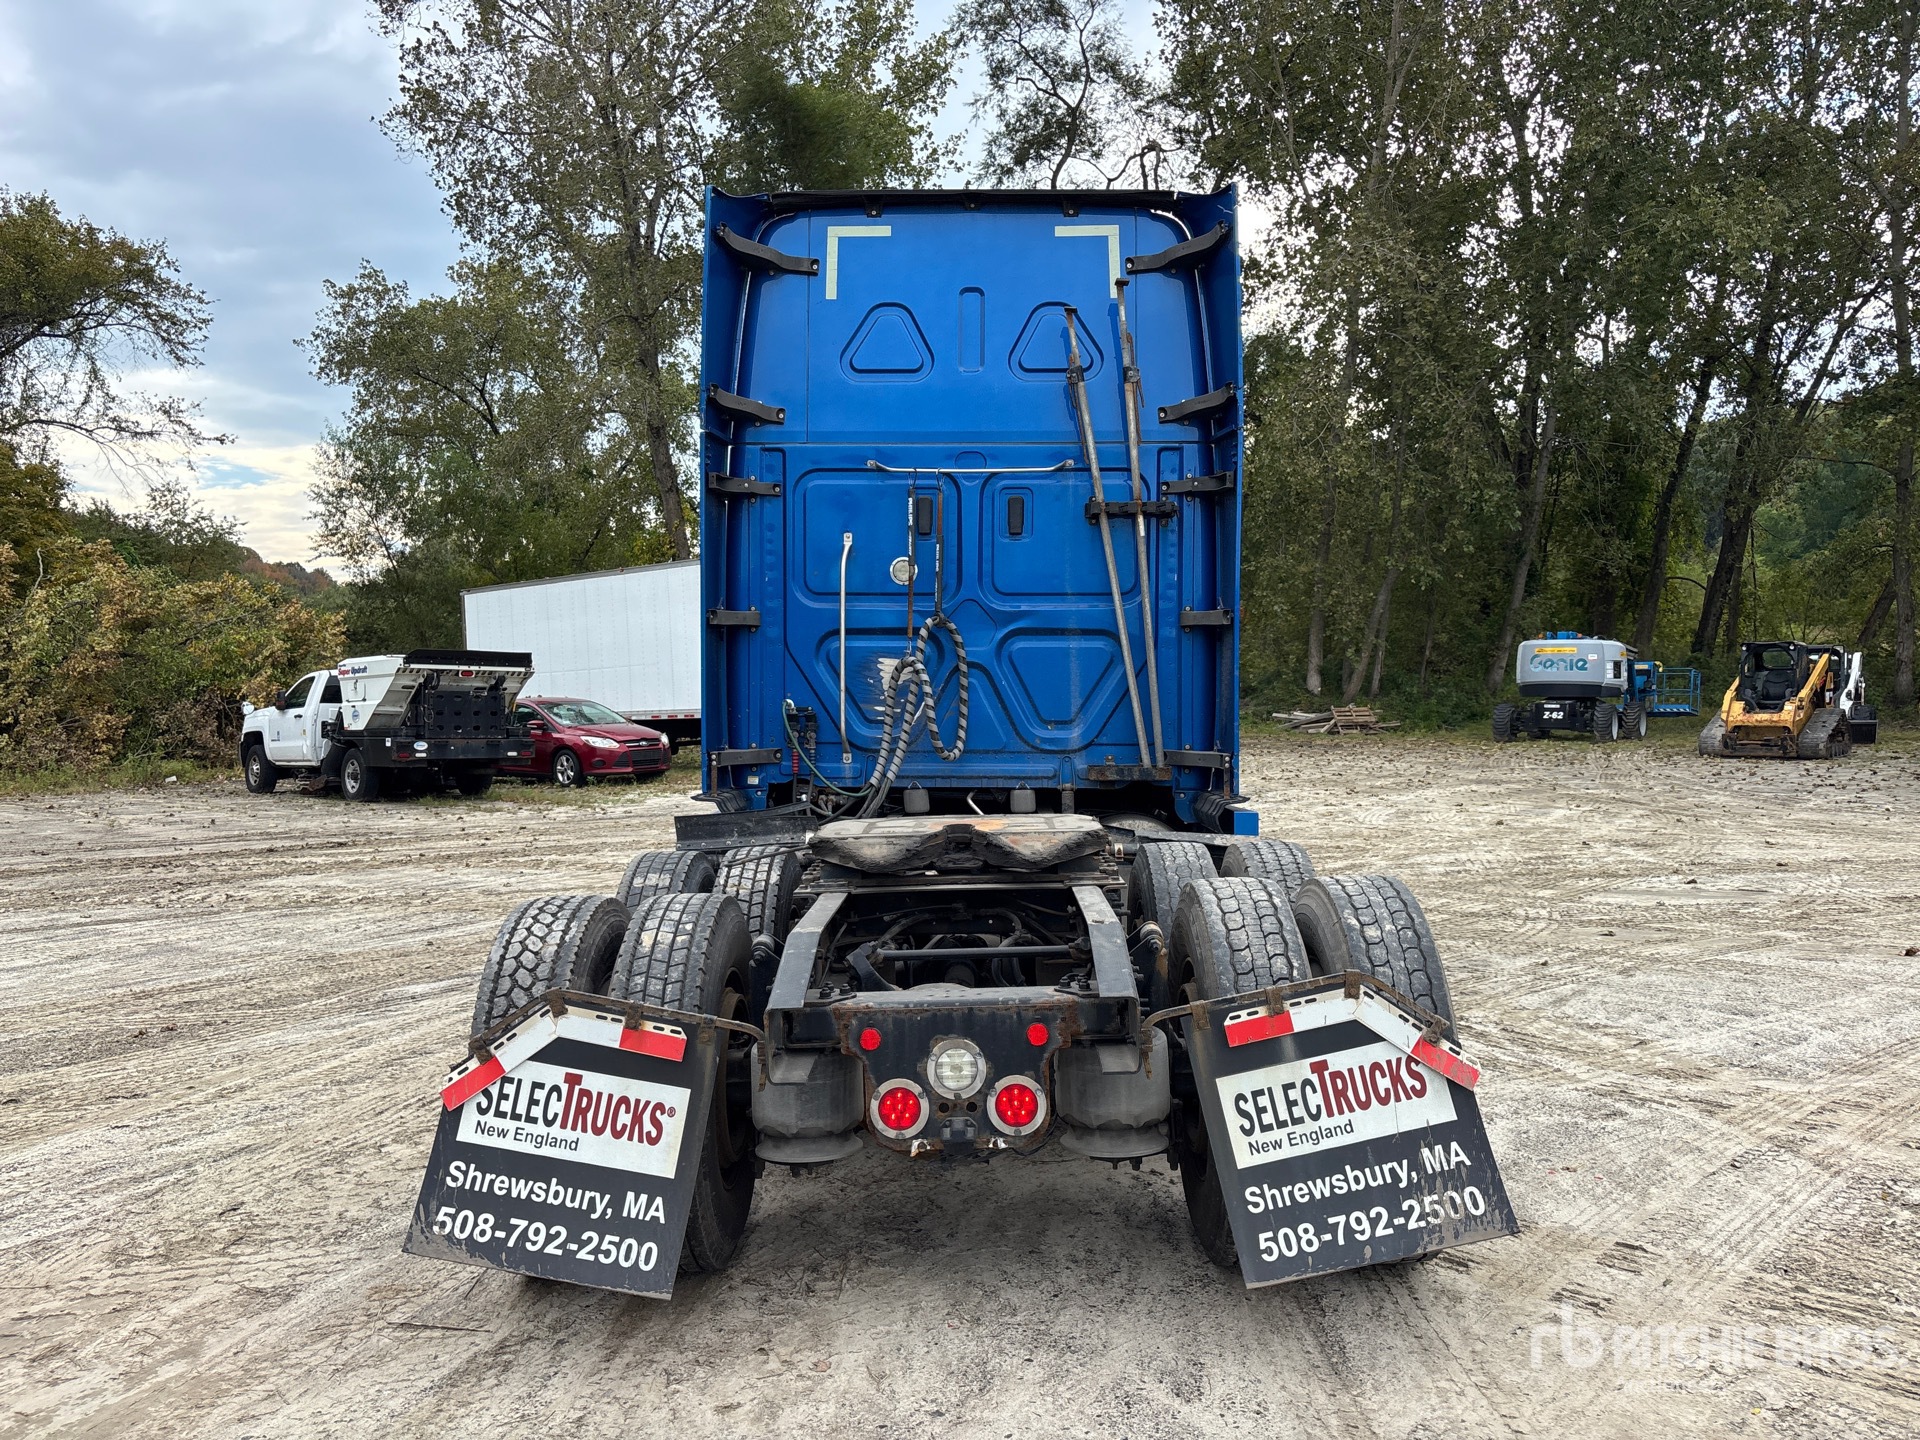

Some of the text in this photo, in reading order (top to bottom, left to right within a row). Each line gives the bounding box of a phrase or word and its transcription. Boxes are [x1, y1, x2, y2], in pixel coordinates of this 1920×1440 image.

[1530, 654, 1588, 672] Genie
[1542, 711, 1564, 719] Z-62
[1233, 1054, 1428, 1138] SELECTRUCKS
[474, 1120, 580, 1152] New England
[1248, 1119, 1355, 1156] New England
[445, 1160, 666, 1224] Shrewsbury, MA
[1244, 1140, 1472, 1214] Shrewsbury, MA
[432, 1206, 658, 1272] 508-792-2500
[1258, 1185, 1486, 1262] 508-792-2500
